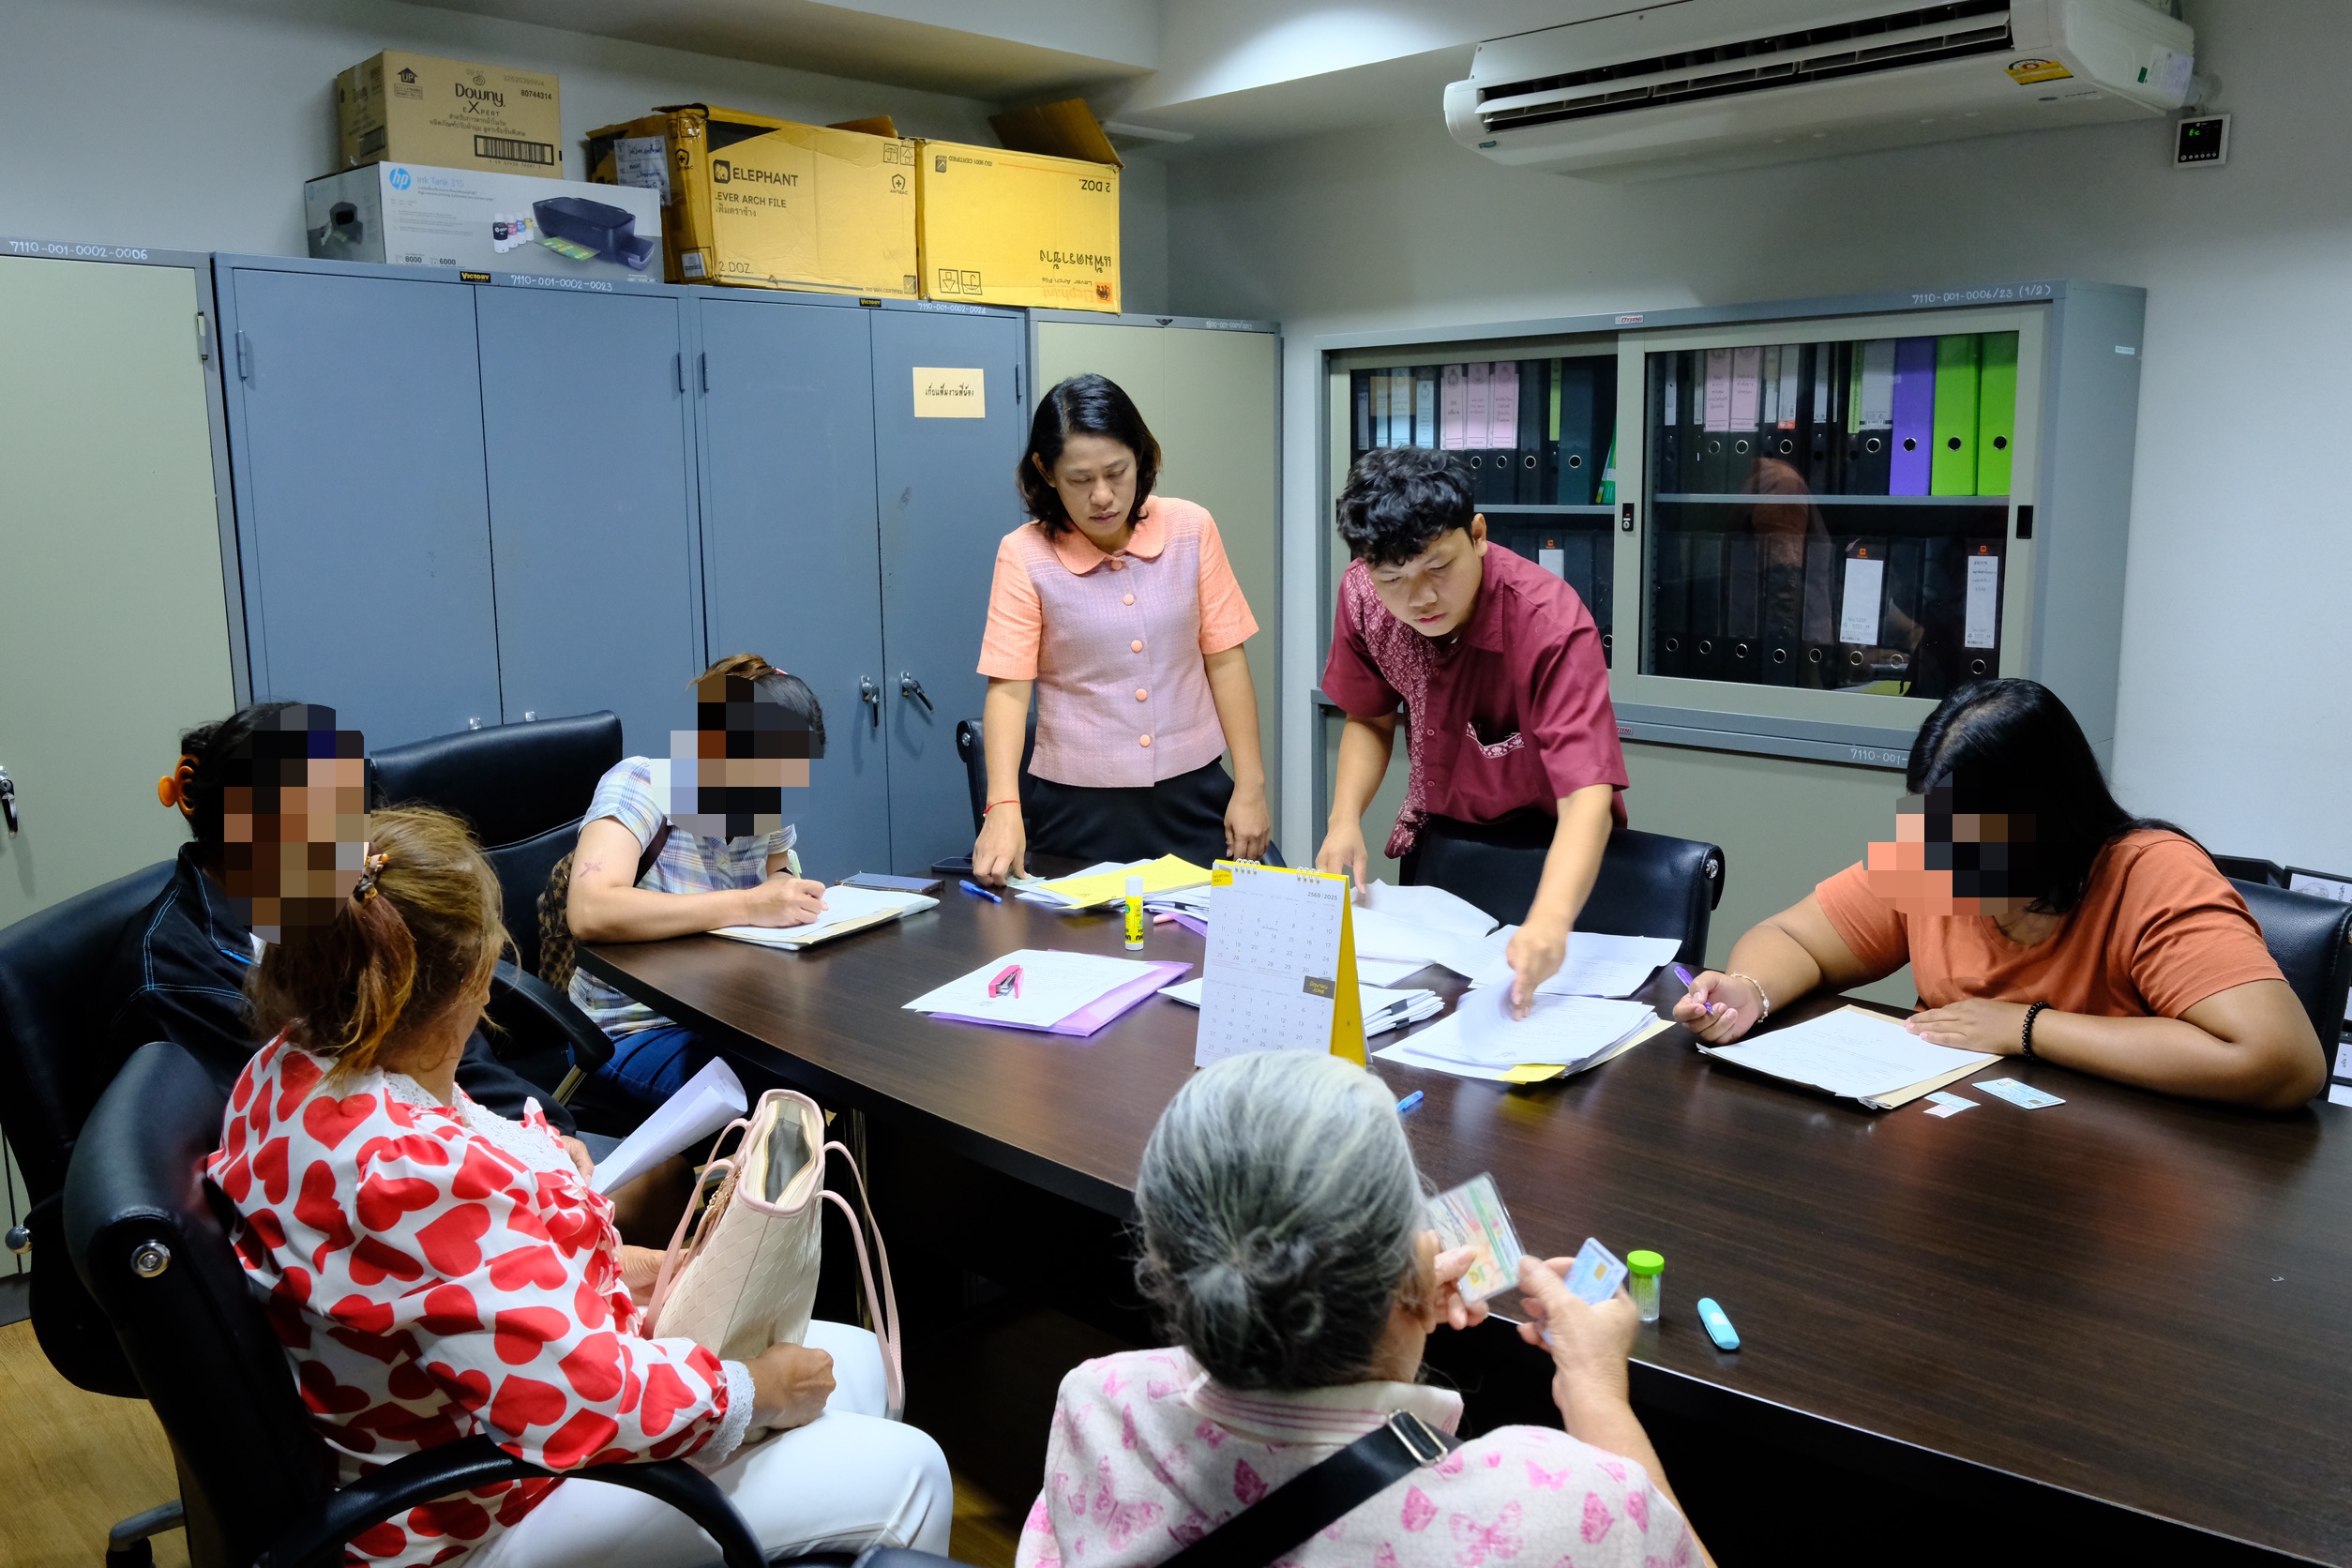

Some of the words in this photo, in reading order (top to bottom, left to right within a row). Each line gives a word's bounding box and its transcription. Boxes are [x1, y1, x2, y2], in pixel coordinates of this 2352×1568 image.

[401, 72, 413, 83] UP
[455, 83, 504, 107] Downy
[520, 89, 552, 100] 80744314
[462, 100, 500, 117] EXPERT
[948, 156, 972, 165] CERTIFIED
[390, 168, 411, 190] hp
[417, 176, 430, 185] Ink
[430, 177, 449, 187] Tank
[451, 179, 464, 188] 315
[732, 167, 799, 188] ELEPHANT
[1078, 178, 1104, 192] DOZ.
[1105, 183, 1111, 193] 2
[715, 191, 740, 204] EVER
[742, 194, 766, 205] ARCH
[768, 198, 787, 208] FILE
[405, 256, 422, 264] 8000
[439, 258, 457, 266] 6000
[719, 261, 725, 272] 2
[1043, 285, 1094, 303] Elephant
[2019, 284, 2051, 298] (1/2)
